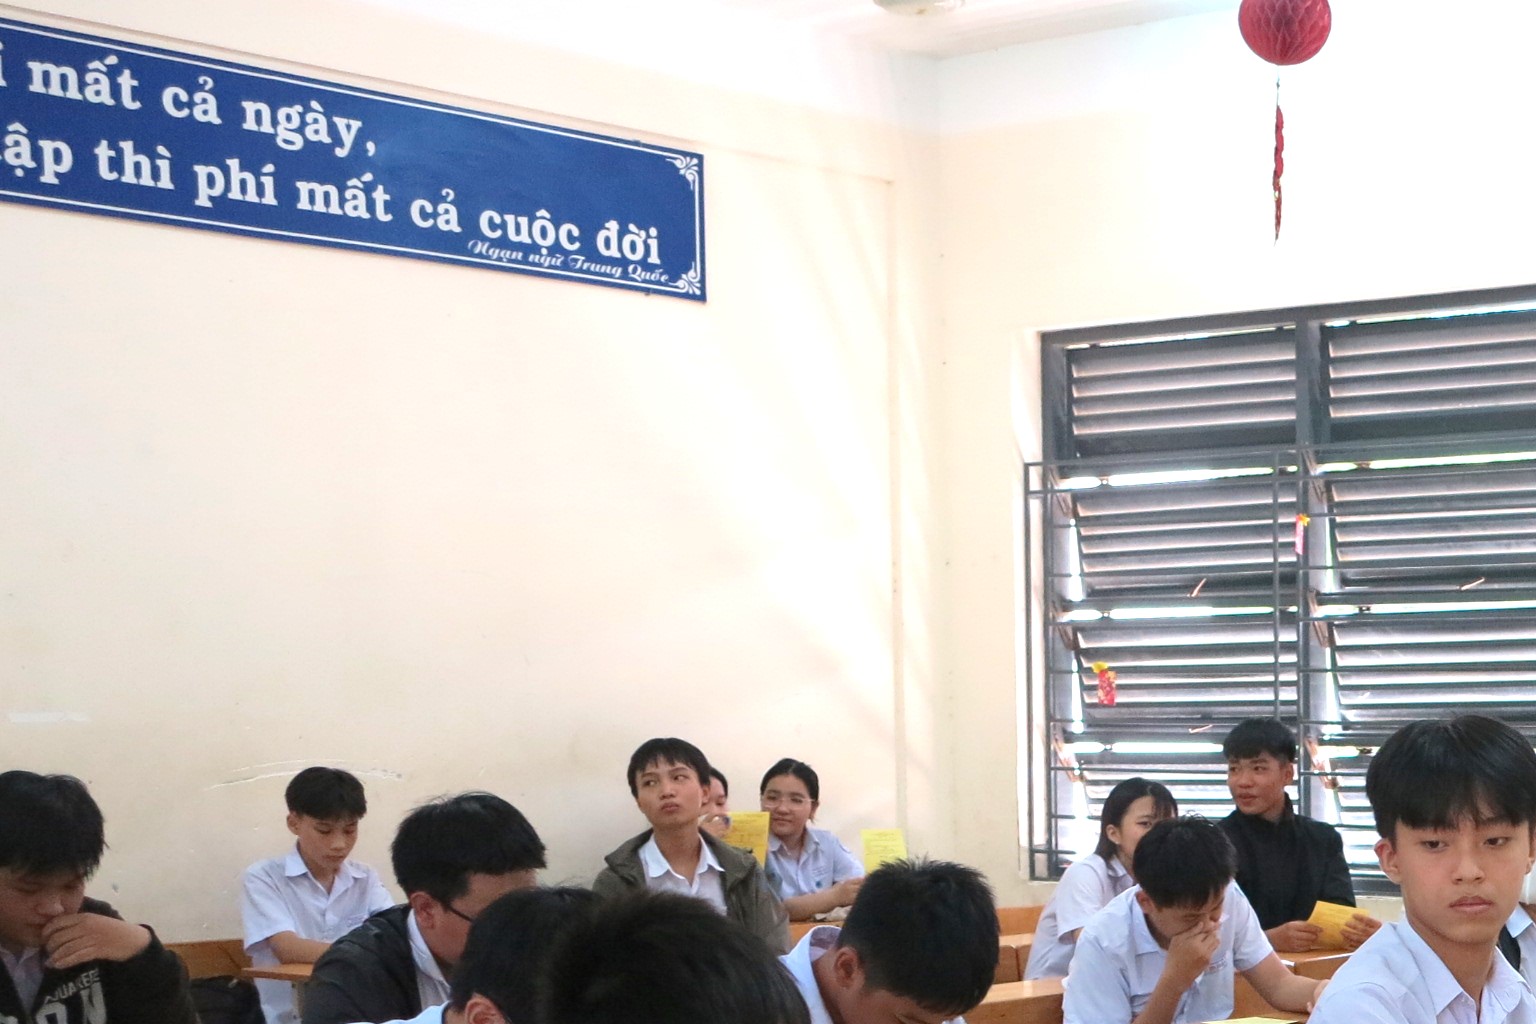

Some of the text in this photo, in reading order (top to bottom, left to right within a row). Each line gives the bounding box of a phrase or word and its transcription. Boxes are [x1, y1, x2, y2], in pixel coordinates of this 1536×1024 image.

[28, 55, 142, 110] mất
[162, 76, 222, 125] cả
[241, 100, 376, 157] ngày,
[0, 122, 661, 265] ập thì phí mất cả cuộc đời
[467, 239, 523, 263] Ngạn
[528, 253, 566, 269] ngữ
[568, 254, 624, 278] Trung
